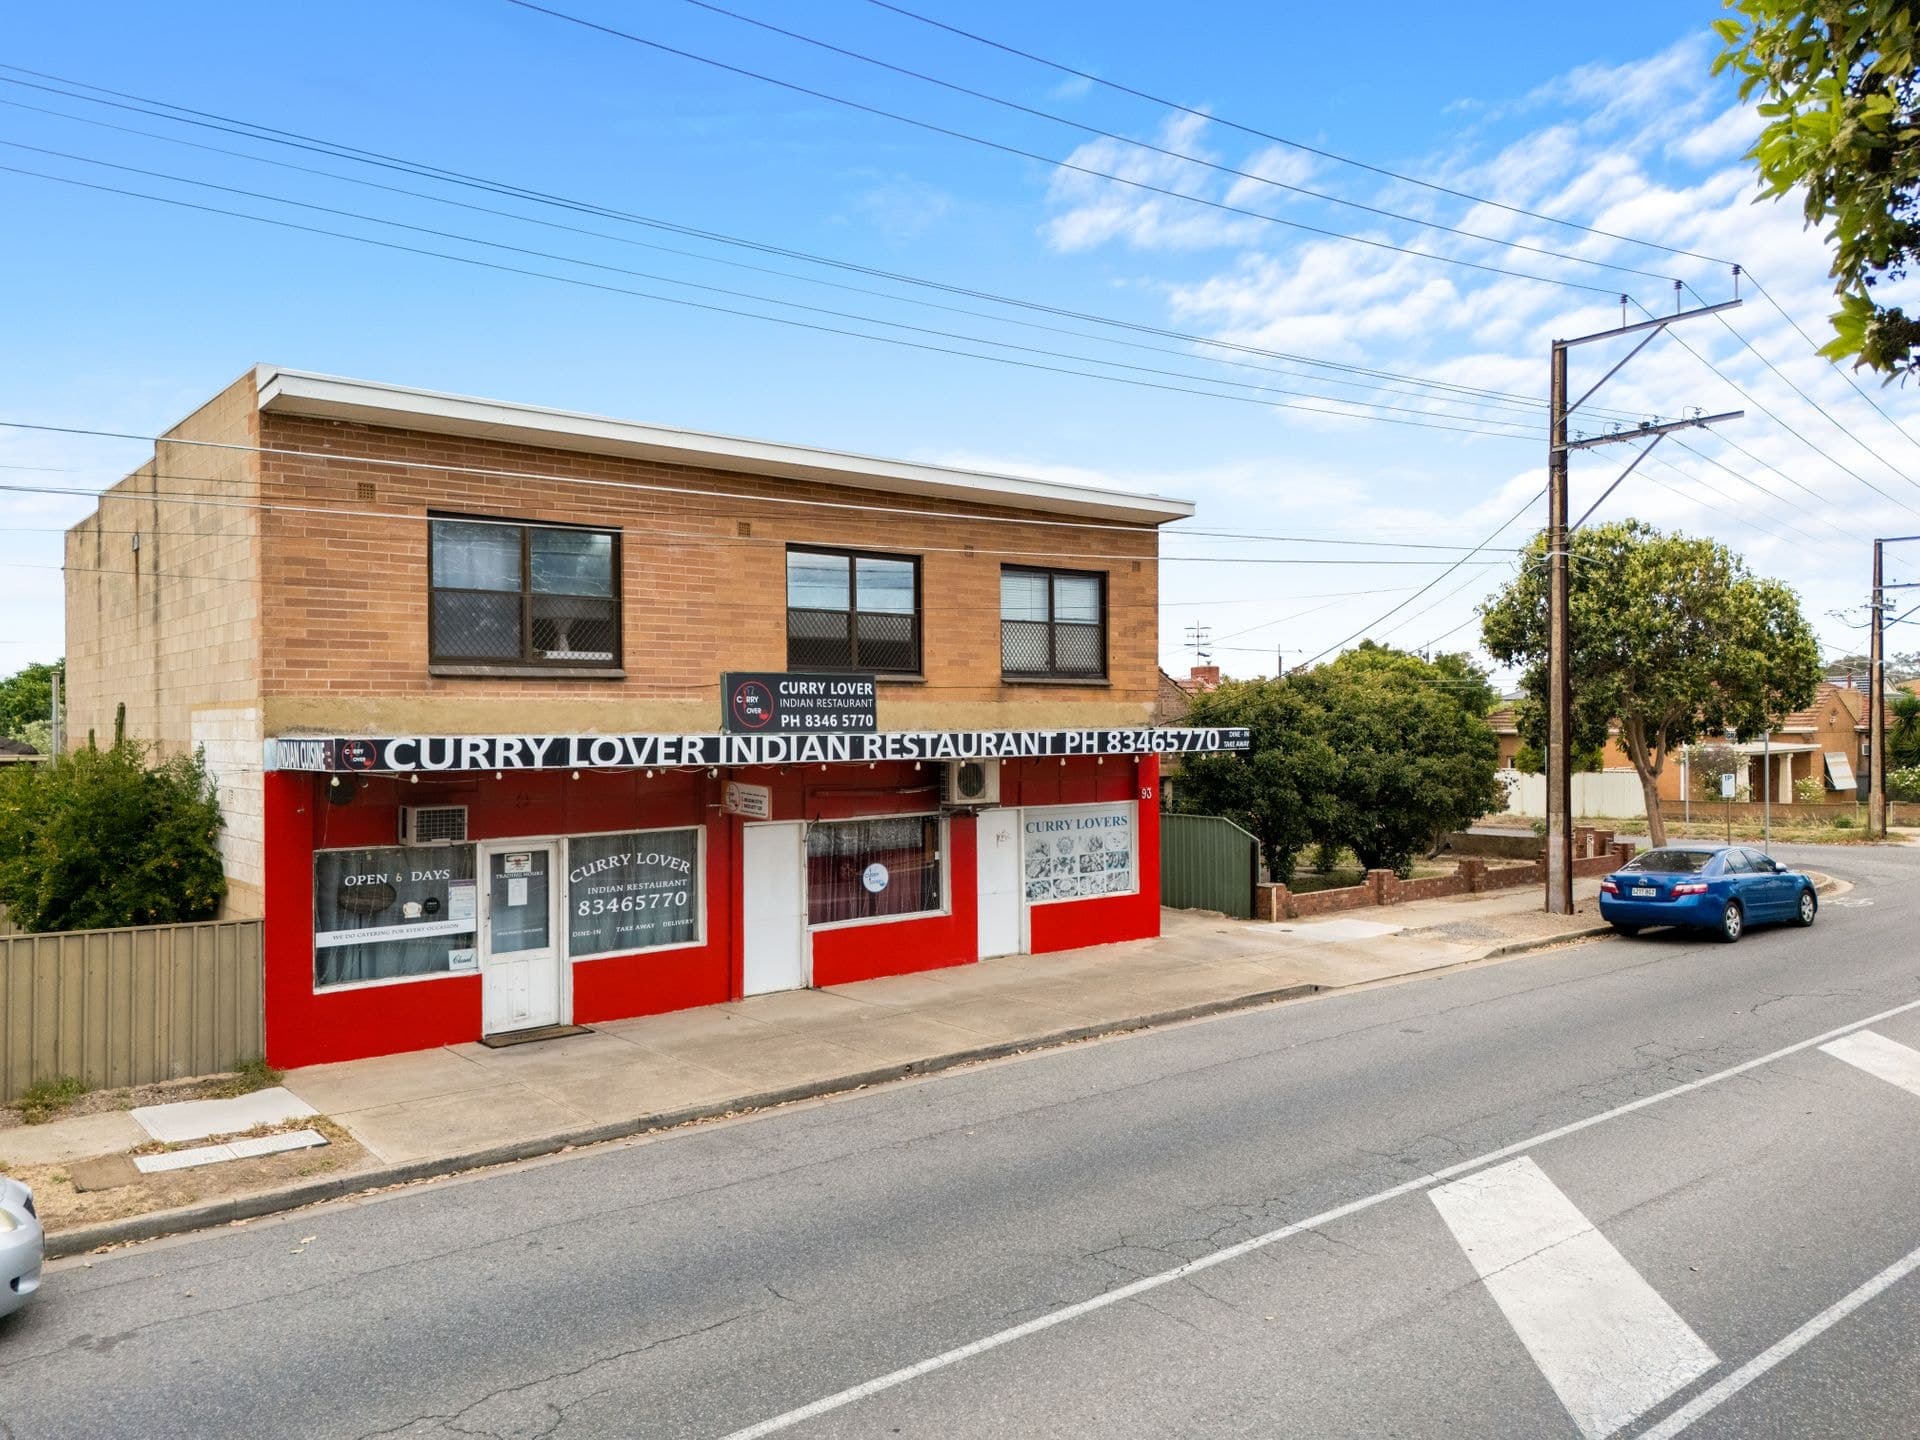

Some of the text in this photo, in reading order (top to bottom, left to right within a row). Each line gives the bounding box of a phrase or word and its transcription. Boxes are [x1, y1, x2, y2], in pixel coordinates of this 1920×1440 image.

[779, 681, 873, 696] CURRY LOVER
[779, 698, 873, 708] INDIAN RESTAURANT
[781, 714, 874, 727] PH 8346 5770
[277, 741, 299, 769] INDIAN
[384, 730, 1220, 770] CURRY LOVER INDIAN RESTAURANT PH 83465770
[1141, 787, 1152, 799] 93
[1025, 815, 1128, 833] CURRY LOVERS
[569, 852, 690, 883] CURRY LOVER
[344, 869, 450, 887] OPEN 6 DAYS
[587, 878, 688, 895] INDIAN RESTAURANT
[578, 891, 688, 916] 83465770
[572, 918, 694, 938] DINE-IN TAKE AWAY DELIVERY
